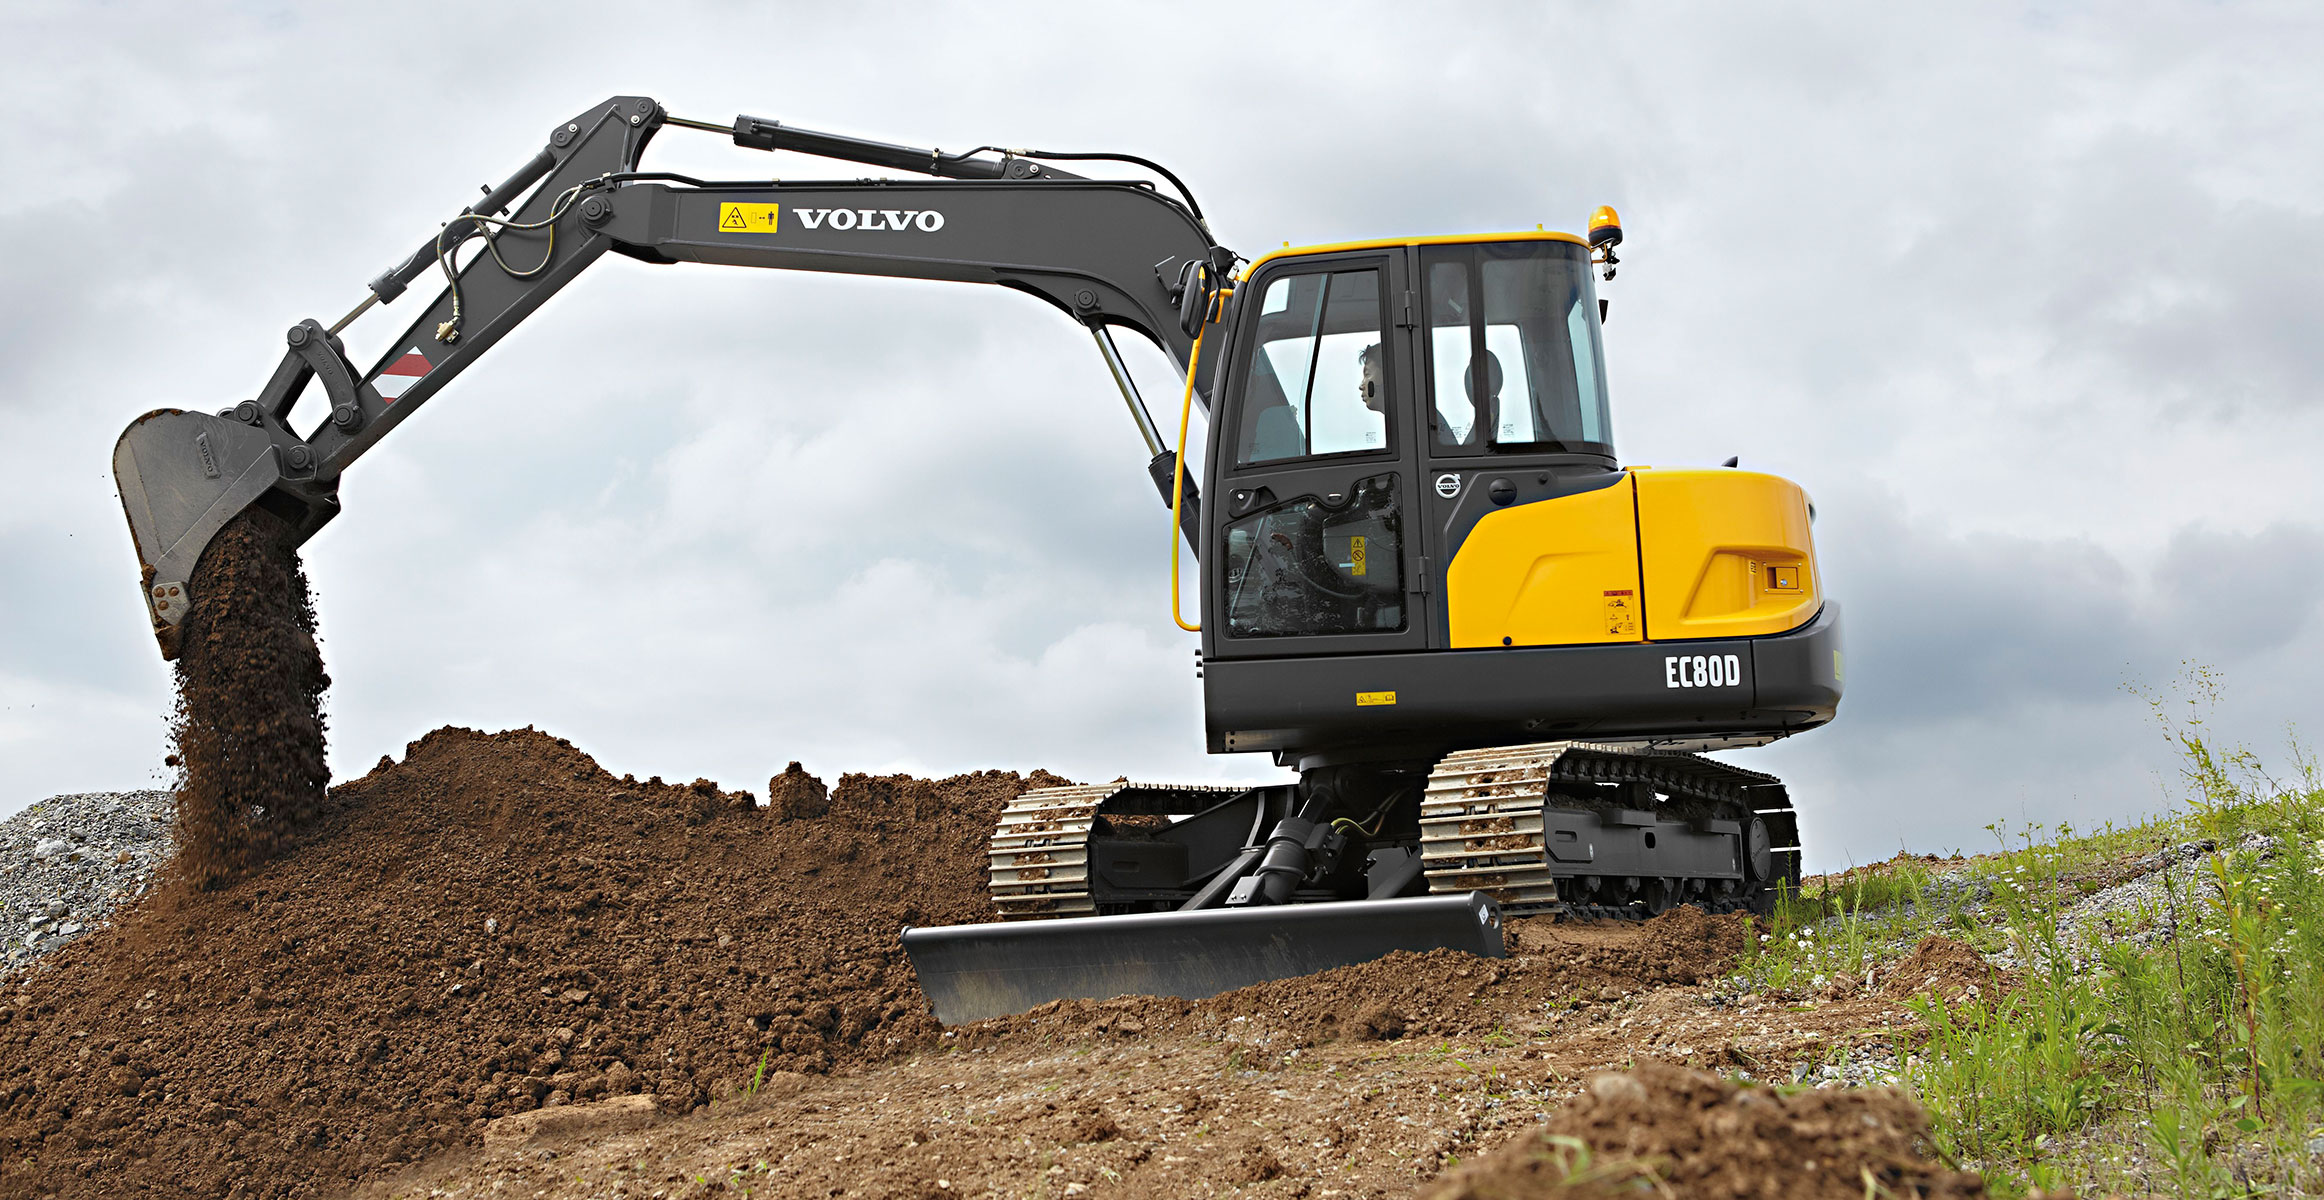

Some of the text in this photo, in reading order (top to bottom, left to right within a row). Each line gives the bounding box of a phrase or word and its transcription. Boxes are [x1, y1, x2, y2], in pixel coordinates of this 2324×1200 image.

[792, 208, 945, 232] VOLVO
[200, 438, 213, 472] VOLVO
[1665, 654, 1740, 688] EC80D
